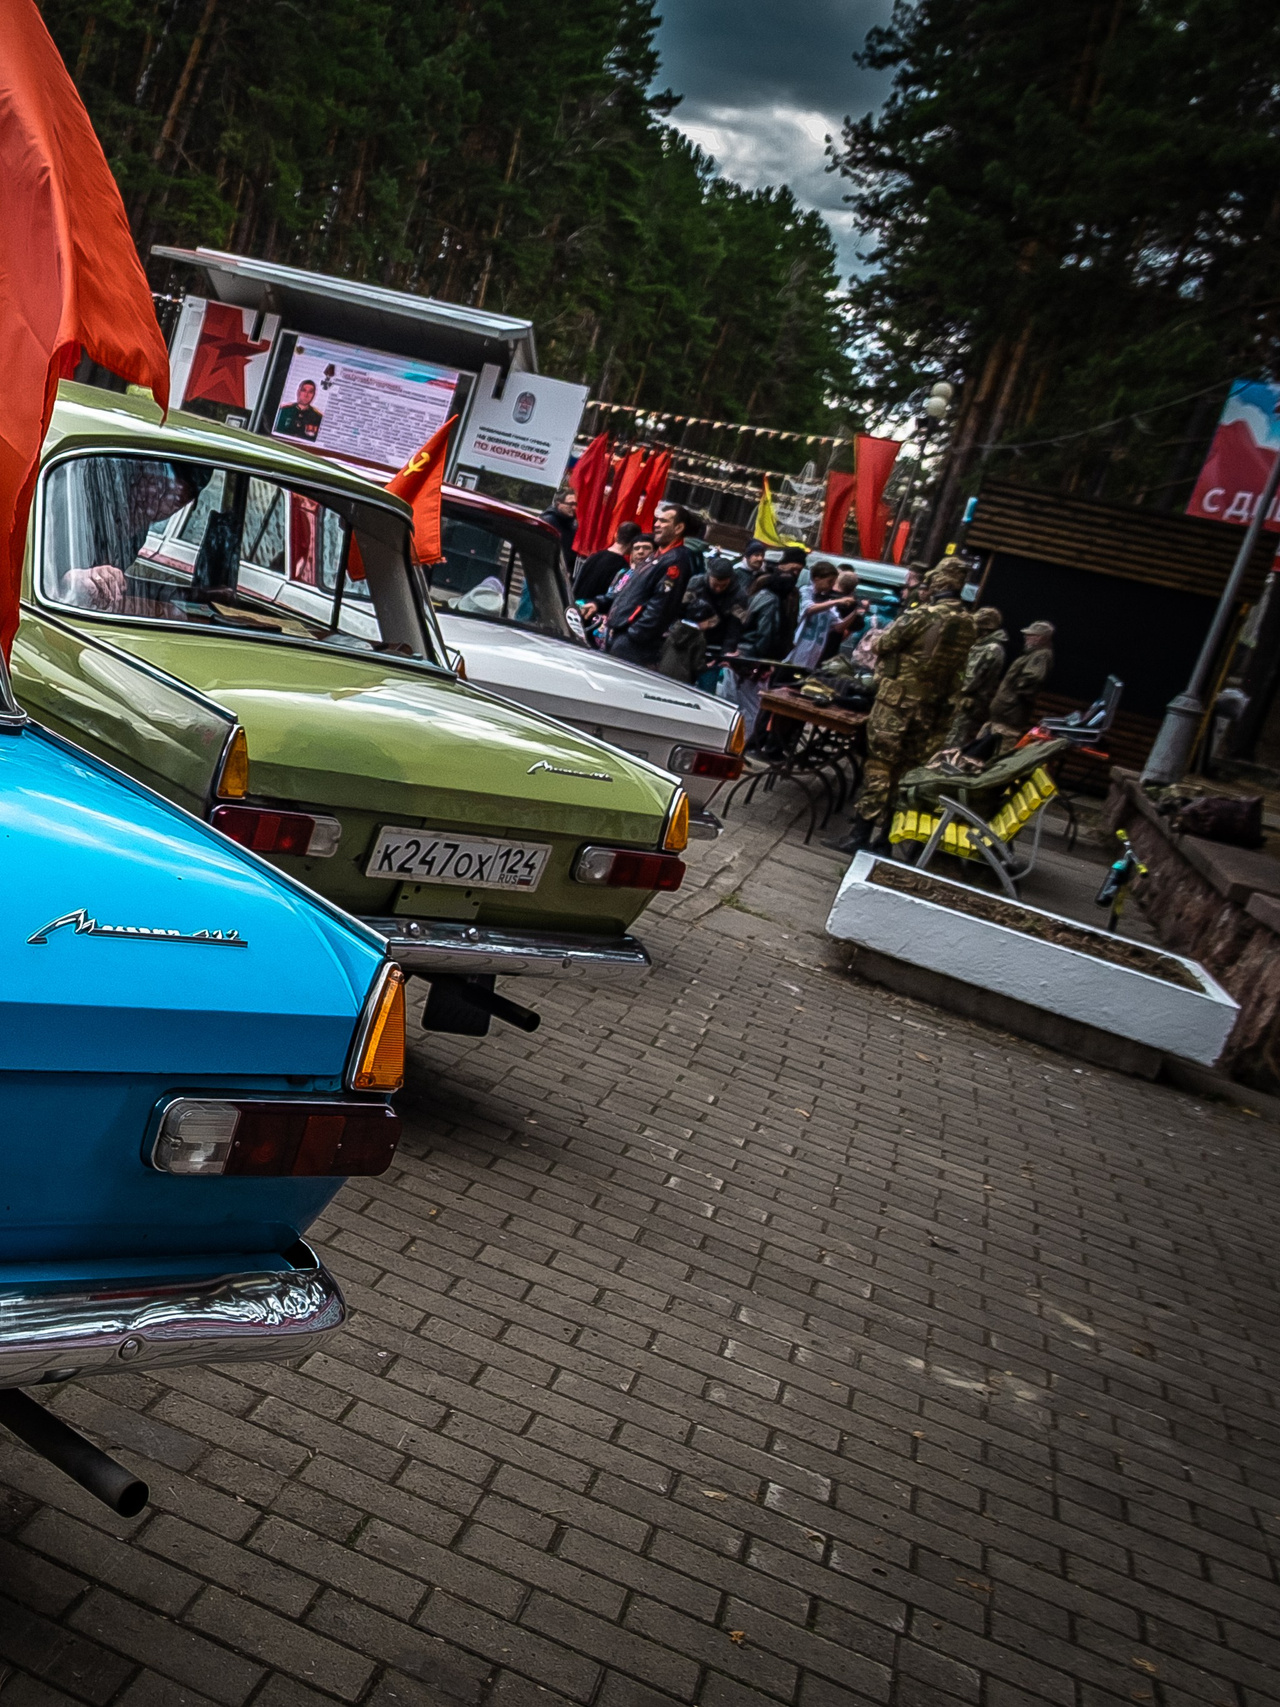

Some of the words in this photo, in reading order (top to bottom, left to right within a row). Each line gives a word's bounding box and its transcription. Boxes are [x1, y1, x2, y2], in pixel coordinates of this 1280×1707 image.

[473, 440, 489, 451] ПО
[489, 445, 547, 465] КОНТРАКТУ
[1202, 487, 1226, 513] С
[378, 839, 493, 882] К247ОХ
[498, 848, 539, 876] 124
[497, 873, 518, 885] RUS
